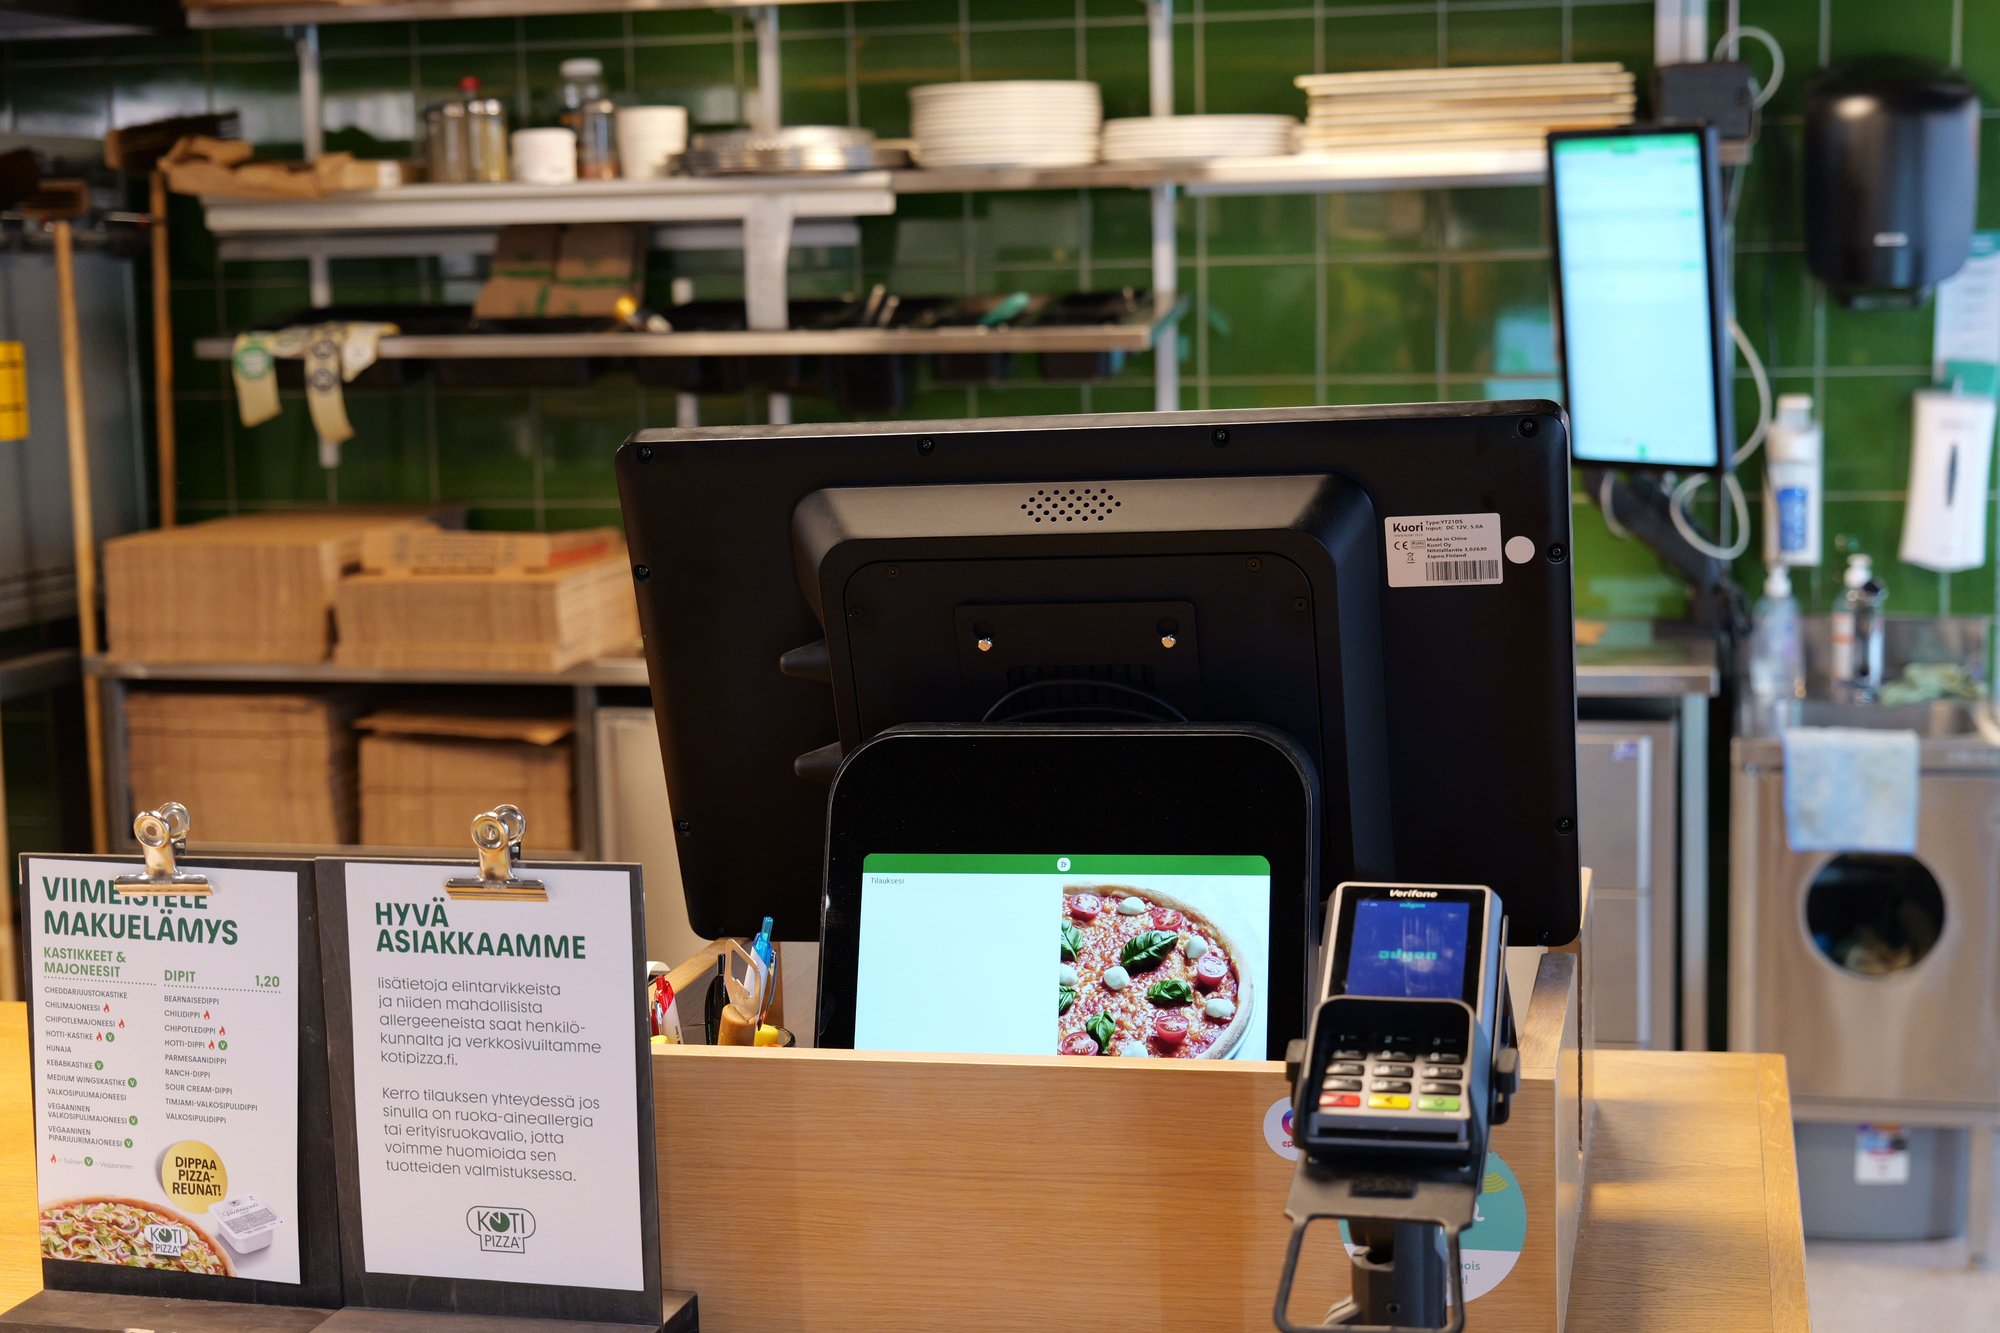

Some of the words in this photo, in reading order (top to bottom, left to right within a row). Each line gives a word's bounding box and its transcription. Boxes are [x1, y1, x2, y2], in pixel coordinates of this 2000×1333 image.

[1393, 522, 1423, 532] Kuori
[1390, 889, 1438, 898] Verifone
[375, 897, 449, 928] HYVÄ
[44, 908, 238, 945] MAKUELÄMYS
[376, 929, 586, 959] ASIAKKAAMME
[44, 946, 112, 962] KASTIKKEET
[116, 952, 126, 962] &
[1378, 948, 1438, 962] adyen
[44, 962, 120, 978] MAJONEESIT
[164, 970, 196, 983] DIPIT
[255, 975, 280, 988] 1,20
[452, 979, 561, 996] elintarvikkeista
[44, 986, 128, 999] CHEDDARJUUSTOKASTIKE
[45, 1001, 100, 1012] CHILIMAJONEESI
[164, 995, 220, 1005] BEARNAISEDIPPI
[378, 994, 392, 1009] ja
[396, 995, 442, 1010] niiden
[446, 998, 543, 1014] mahdollisista
[164, 1010, 200, 1018] CHILIDIPPI
[46, 1016, 116, 1027] CHIPOTLEMAJONEESI
[379, 1014, 485, 1030] allergeeneista
[489, 1018, 522, 1032] saat
[526, 1018, 586, 1034] henkilö-
[46, 1030, 94, 1040] HOTTI-KASTIKE
[164, 1024, 216, 1034] CHIPOTLEDIPPI
[46, 1044, 72, 1053] HUNAJA
[164, 1040, 205, 1048] HOTTI-DIPPI
[380, 1032, 444, 1047] kunnalta
[447, 1034, 461, 1048] ja
[465, 1037, 602, 1054] verkkosivuiltamme
[46, 1060, 92, 1069] KEBABKASTIKE
[164, 1054, 226, 1064] PARMESAANIDIPPI
[380, 1050, 458, 1066] kotipizza.fi.
[165, 1068, 210, 1078] RANCH-DIPPI
[47, 1074, 74, 1082] MEDIUM
[76, 1076, 126, 1086] WINGSKASTIKE
[47, 1088, 126, 1101] VALKOSIPULIMAJONEESI
[165, 1083, 184, 1092] SOUR
[186, 1084, 232, 1095] CREAM-DIPPI
[166, 1098, 258, 1112] TIMJAMI-VALKOSIPULIDIPPI
[382, 1087, 420, 1100] Kerro
[423, 1088, 488, 1104] tilauksen
[491, 1092, 575, 1110] yhteydessä
[578, 1096, 600, 1110] jos
[48, 1102, 90, 1112] VEGAANINEN
[48, 1111, 128, 1124] VALKOSIPULIMAJONEESI
[166, 1112, 226, 1124] VALKOSIPULIDIPPI
[382, 1106, 428, 1120] sinulla
[432, 1110, 452, 1120] on
[455, 1110, 594, 1129] ruoka-aineallergia
[48, 1126, 91, 1136] VEGAANINEN
[384, 1124, 402, 1136] tai
[406, 1126, 528, 1144] erityisruokavalio,
[530, 1132, 564, 1146] jotta
[48, 1134, 122, 1147] PIPARJUURIMAJONEESI
[385, 1141, 442, 1156] voimme
[446, 1144, 526, 1161] huomioida
[530, 1150, 556, 1162] sen
[176, 1156, 216, 1170] DIPPAA
[178, 1169, 214, 1182] PIZZA-
[386, 1159, 461, 1175] tuotteiden
[464, 1164, 577, 1182] valmistuksessa.
[172, 1182, 222, 1196] REUNAT!
[477, 1210, 525, 1234] KOTI
[150, 1227, 182, 1244] KOTI
[484, 1234, 520, 1249] PIZZA
[156, 1244, 179, 1254] PIZZA
